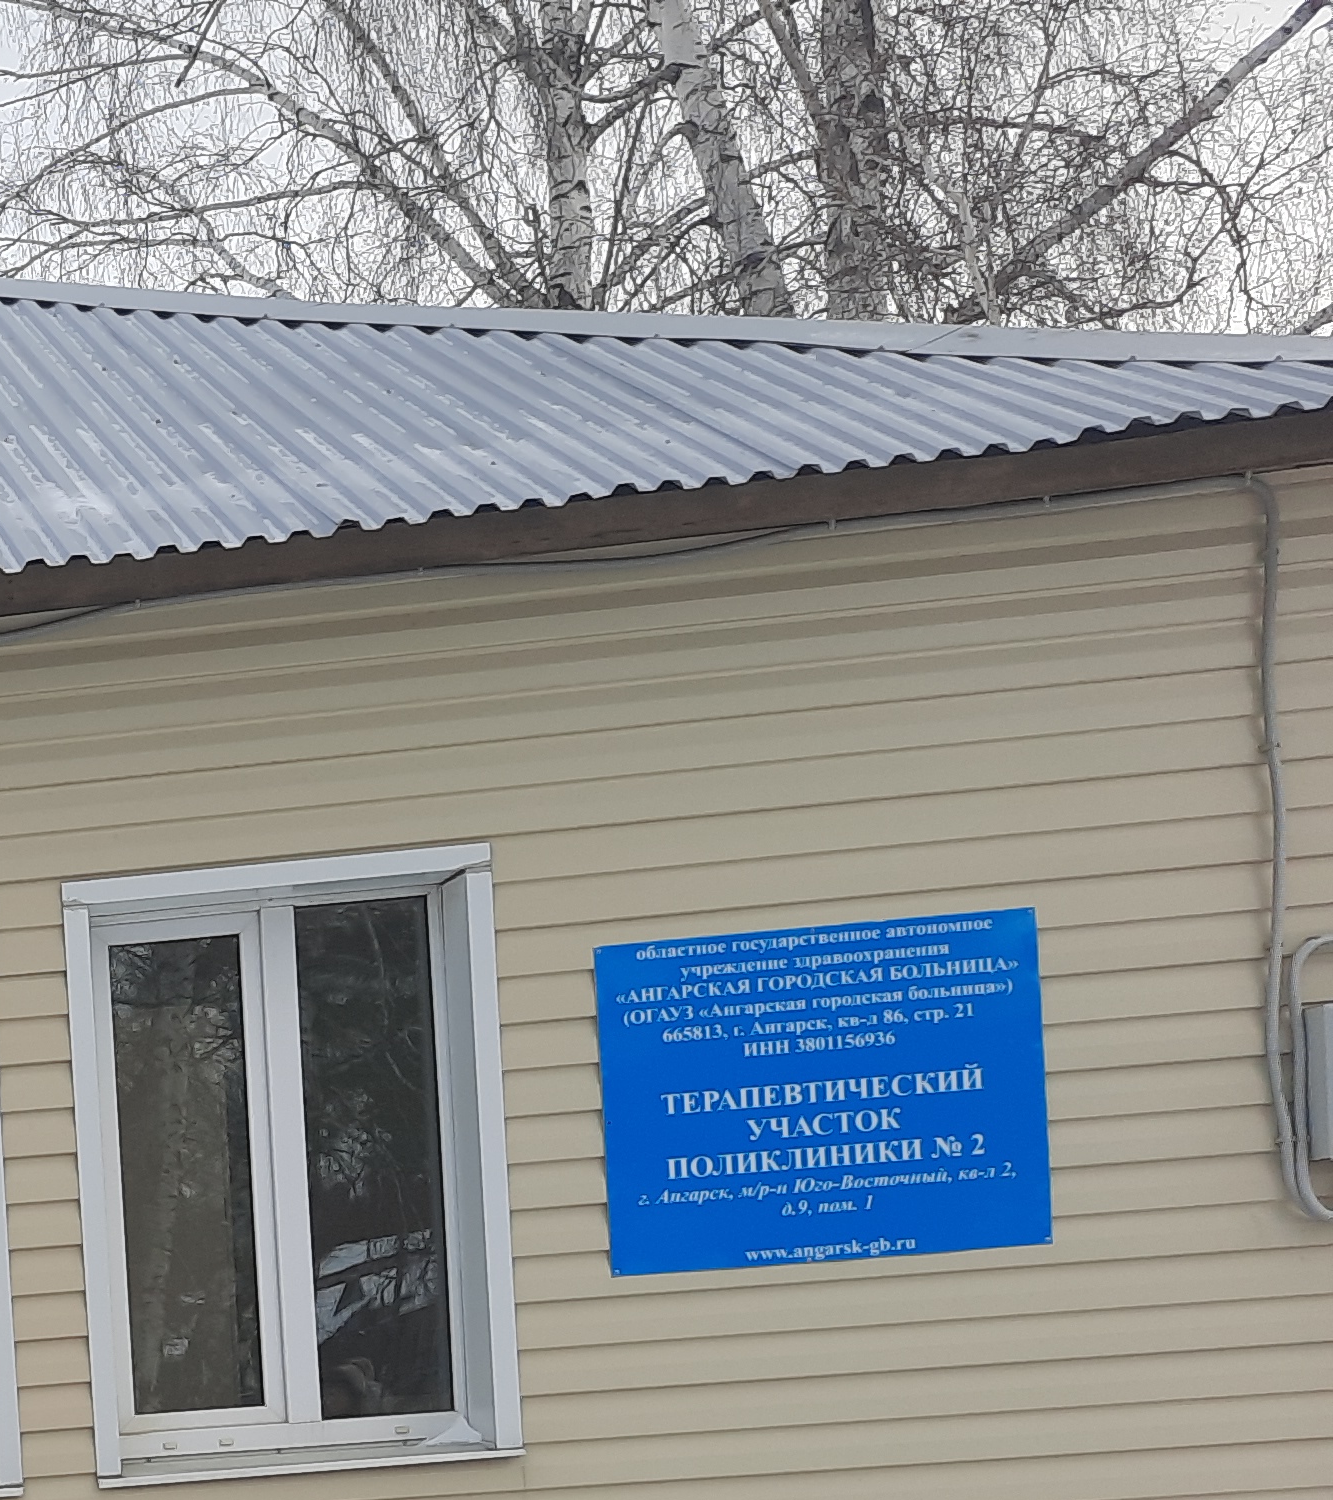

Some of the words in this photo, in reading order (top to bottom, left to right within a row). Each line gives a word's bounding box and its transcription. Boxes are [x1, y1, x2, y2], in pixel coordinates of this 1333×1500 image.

[636, 945, 726, 961] областное
[732, 928, 880, 954] государственное
[886, 918, 993, 938] автономное
[616, 978, 750, 1004] «АНГАРСКАЯ
[757, 967, 883, 992] ГОРОДСКАЯ
[889, 957, 1019, 981] БОЛЬНИЦА»
[680, 957, 788, 982] учреждение
[793, 943, 949, 970] здравоохранения
[623, 1006, 693, 1028] (ОГАУЗ
[699, 998, 807, 1018] «Ангарская
[812, 989, 903, 1011] городская
[908, 978, 1013, 1000] больница»)
[662, 1024, 729, 1043] 665813,
[733, 1027, 745, 1037] г.
[749, 1018, 833, 1036] Ангарск,
[883, 1009, 909, 1024] 86,
[913, 1008, 949, 1024] стр.
[953, 1002, 974, 1018] 21
[743, 1040, 791, 1057] ИНН
[795, 1031, 896, 1053] 3801156936
[660, 1063, 984, 1116] ТЕРАПЕВТИЧЕСКИЙ
[745, 1107, 901, 1141] УЧАСТОК
[666, 1138, 923, 1180] ПОЛИКЛИНИКИ
[931, 1135, 962, 1158] №
[971, 1133, 985, 1155] 2
[638, 1194, 650, 1206] г.
[655, 1187, 733, 1206] Ангарск,
[737, 1181, 787, 1200] м/р-н
[792, 1167, 952, 1195] Юго-Восточный,
[958, 1167, 996, 1181] кв-л
[999, 1161, 1017, 1179] 2,
[781, 1199, 812, 1217] д.9,
[818, 1199, 857, 1213] пом.
[864, 1194, 874, 1210] 1
[744, 1237, 916, 1262] www.angarsk-gb.ru
